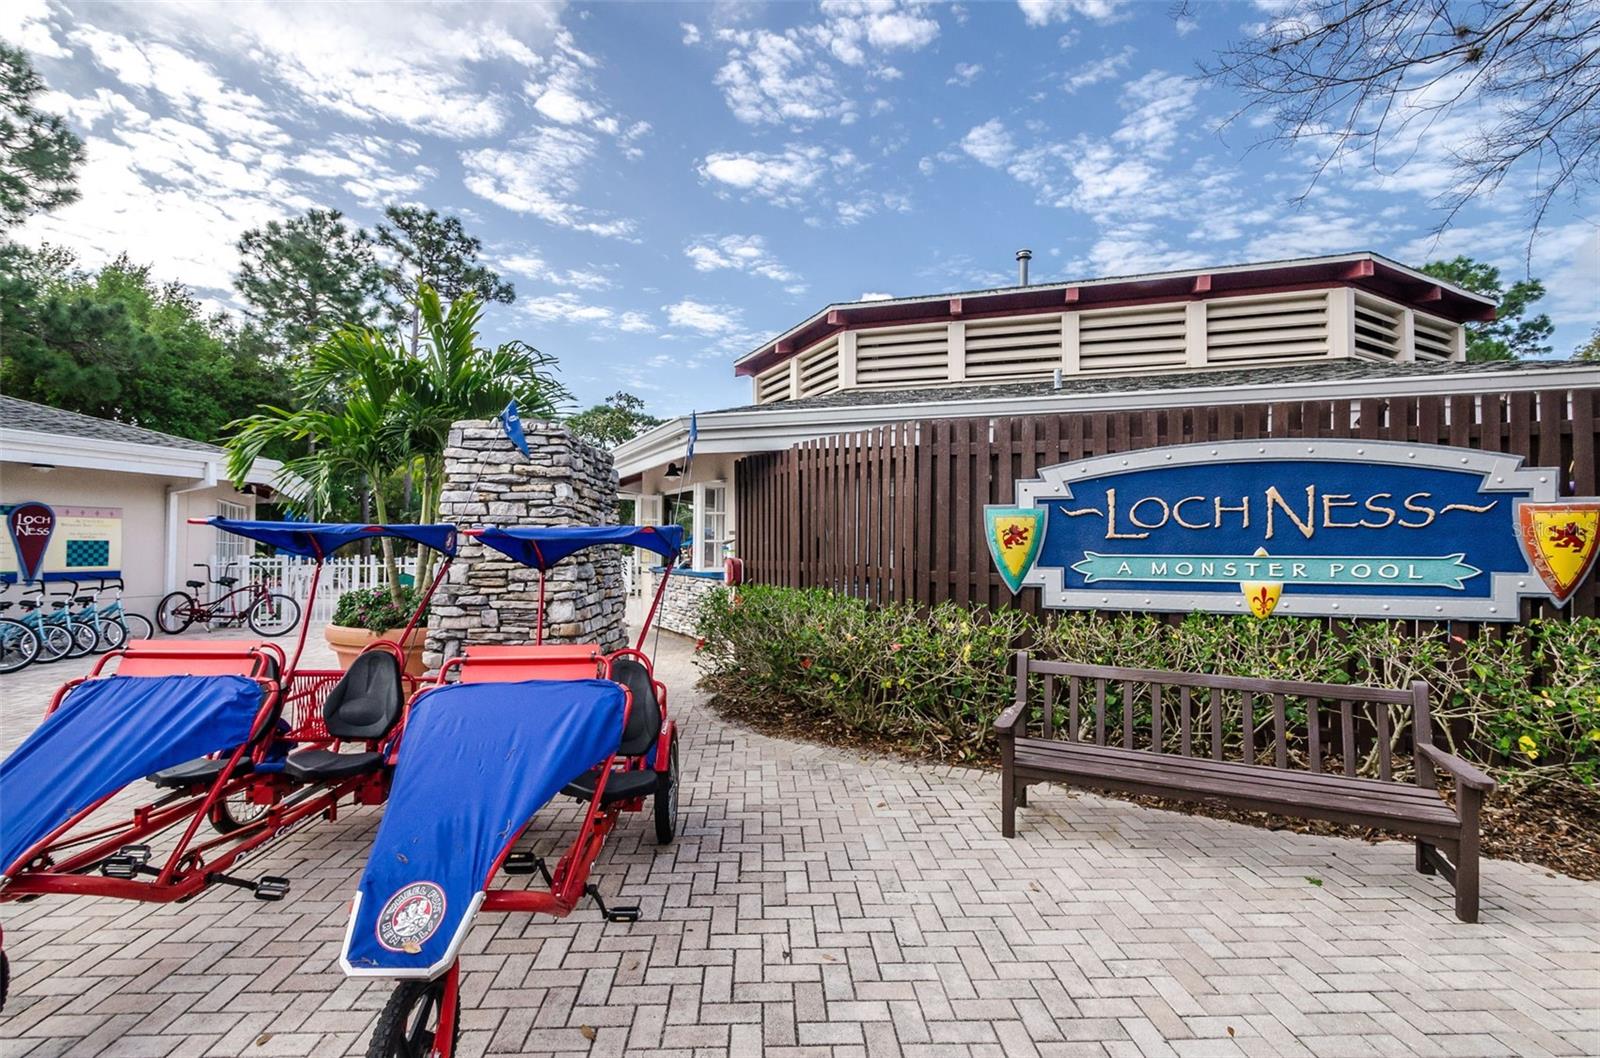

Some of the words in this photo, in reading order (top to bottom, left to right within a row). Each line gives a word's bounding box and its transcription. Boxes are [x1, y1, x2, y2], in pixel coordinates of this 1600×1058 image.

[17, 513, 51, 525] LOCH
[1104, 488, 1250, 540] LOCH
[1264, 484, 1437, 540] NESS
[1116, 561, 1133, 576] A
[1151, 561, 1308, 578] MONSTER
[1329, 563, 1424, 580] POOL
